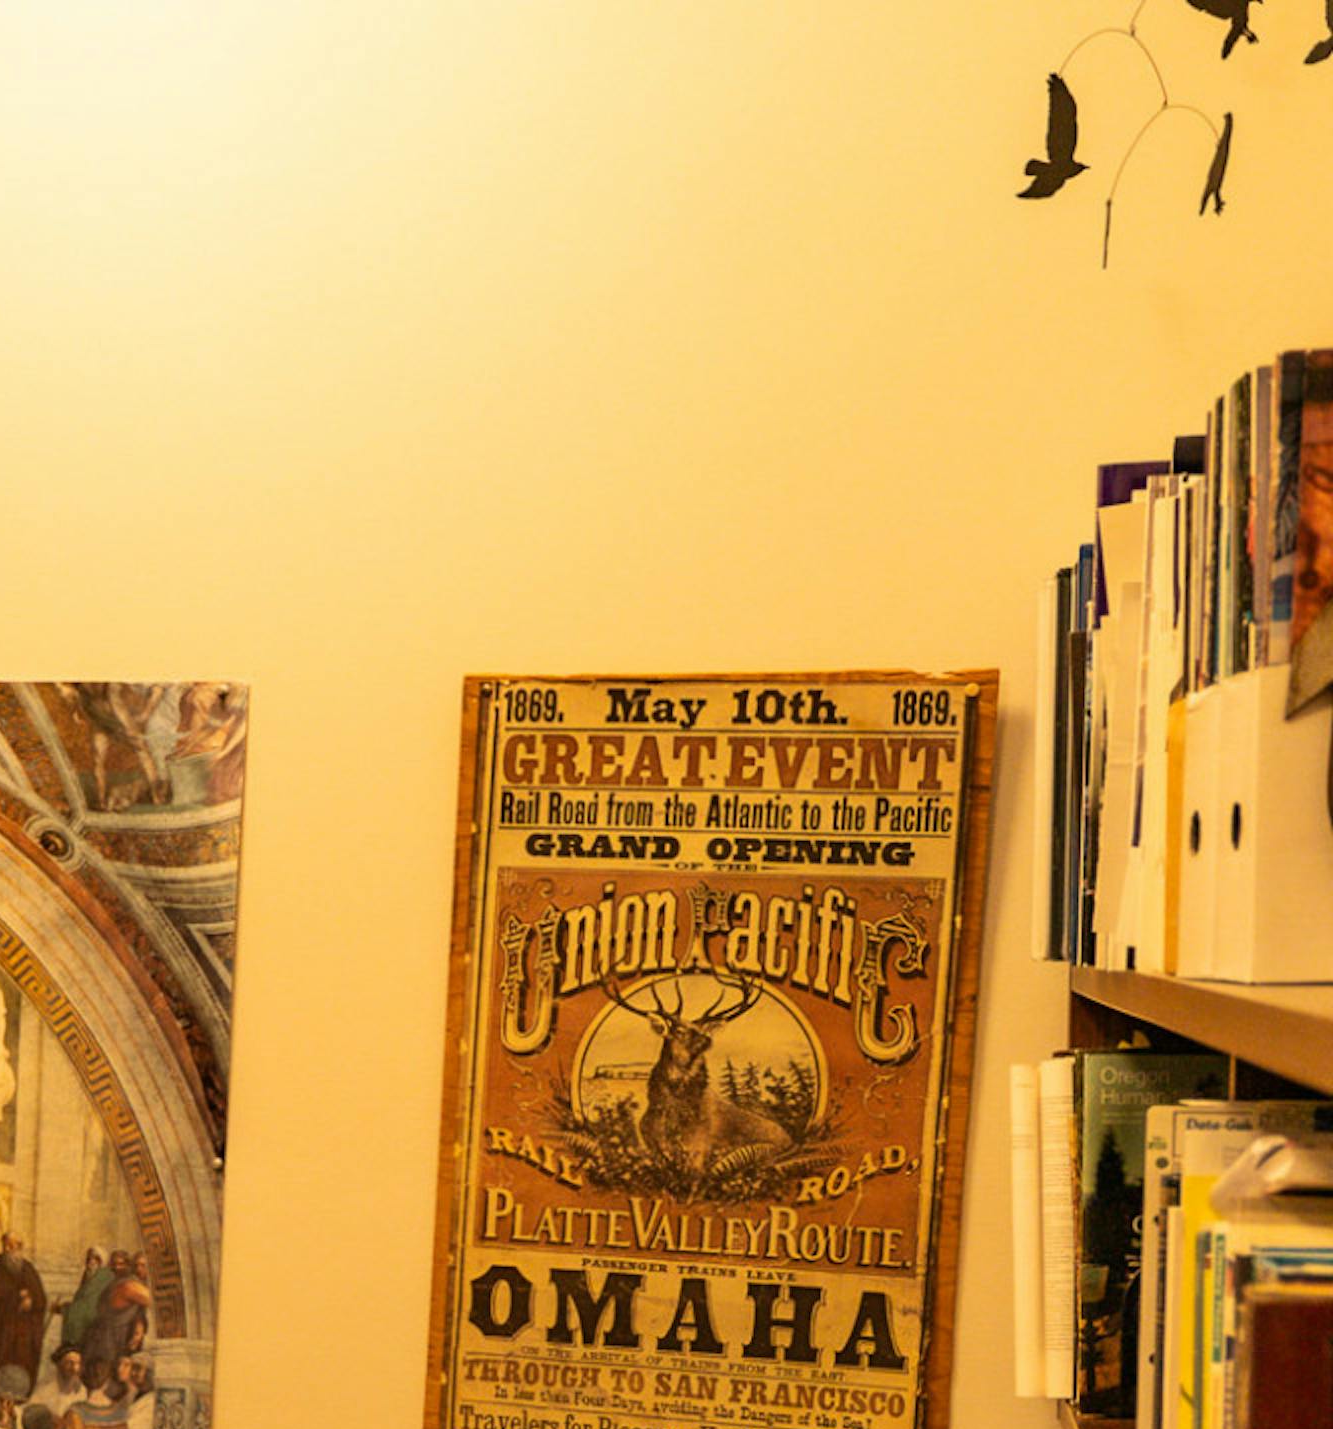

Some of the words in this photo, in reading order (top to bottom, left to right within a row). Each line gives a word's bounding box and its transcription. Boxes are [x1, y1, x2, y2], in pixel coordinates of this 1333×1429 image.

[503, 688, 564, 723] 1869.
[605, 687, 707, 729] May
[731, 688, 848, 725] 10th.
[892, 689, 957, 726] 1869.
[502, 734, 717, 788] GREAT
[724, 736, 957, 790] EVENT
[501, 791, 541, 825] Rail
[548, 791, 599, 826] Road
[606, 793, 654, 827] from
[664, 793, 697, 828] the
[705, 793, 792, 831] Atlantic
[801, 800, 821, 831] to
[833, 796, 866, 831] the
[874, 796, 952, 833] Pacific
[525, 833, 681, 860] GRAND
[706, 837, 915, 866] OPENING
[499, 881, 678, 1055] Union
[1100, 1066, 1170, 1088] Oregon
[485, 1126, 586, 1190] RAIL
[582, 1258, 668, 1273] PASSENGER
[677, 1264, 737, 1278] TRAINS
[746, 1269, 796, 1282] LEAVE
[469, 1264, 906, 1370] OMAHA
[463, 1359, 601, 1389] THROUGH
[610, 1368, 645, 1394] TO
[654, 1372, 718, 1400] SAN
[729, 1378, 906, 1418] FRANCISCO
